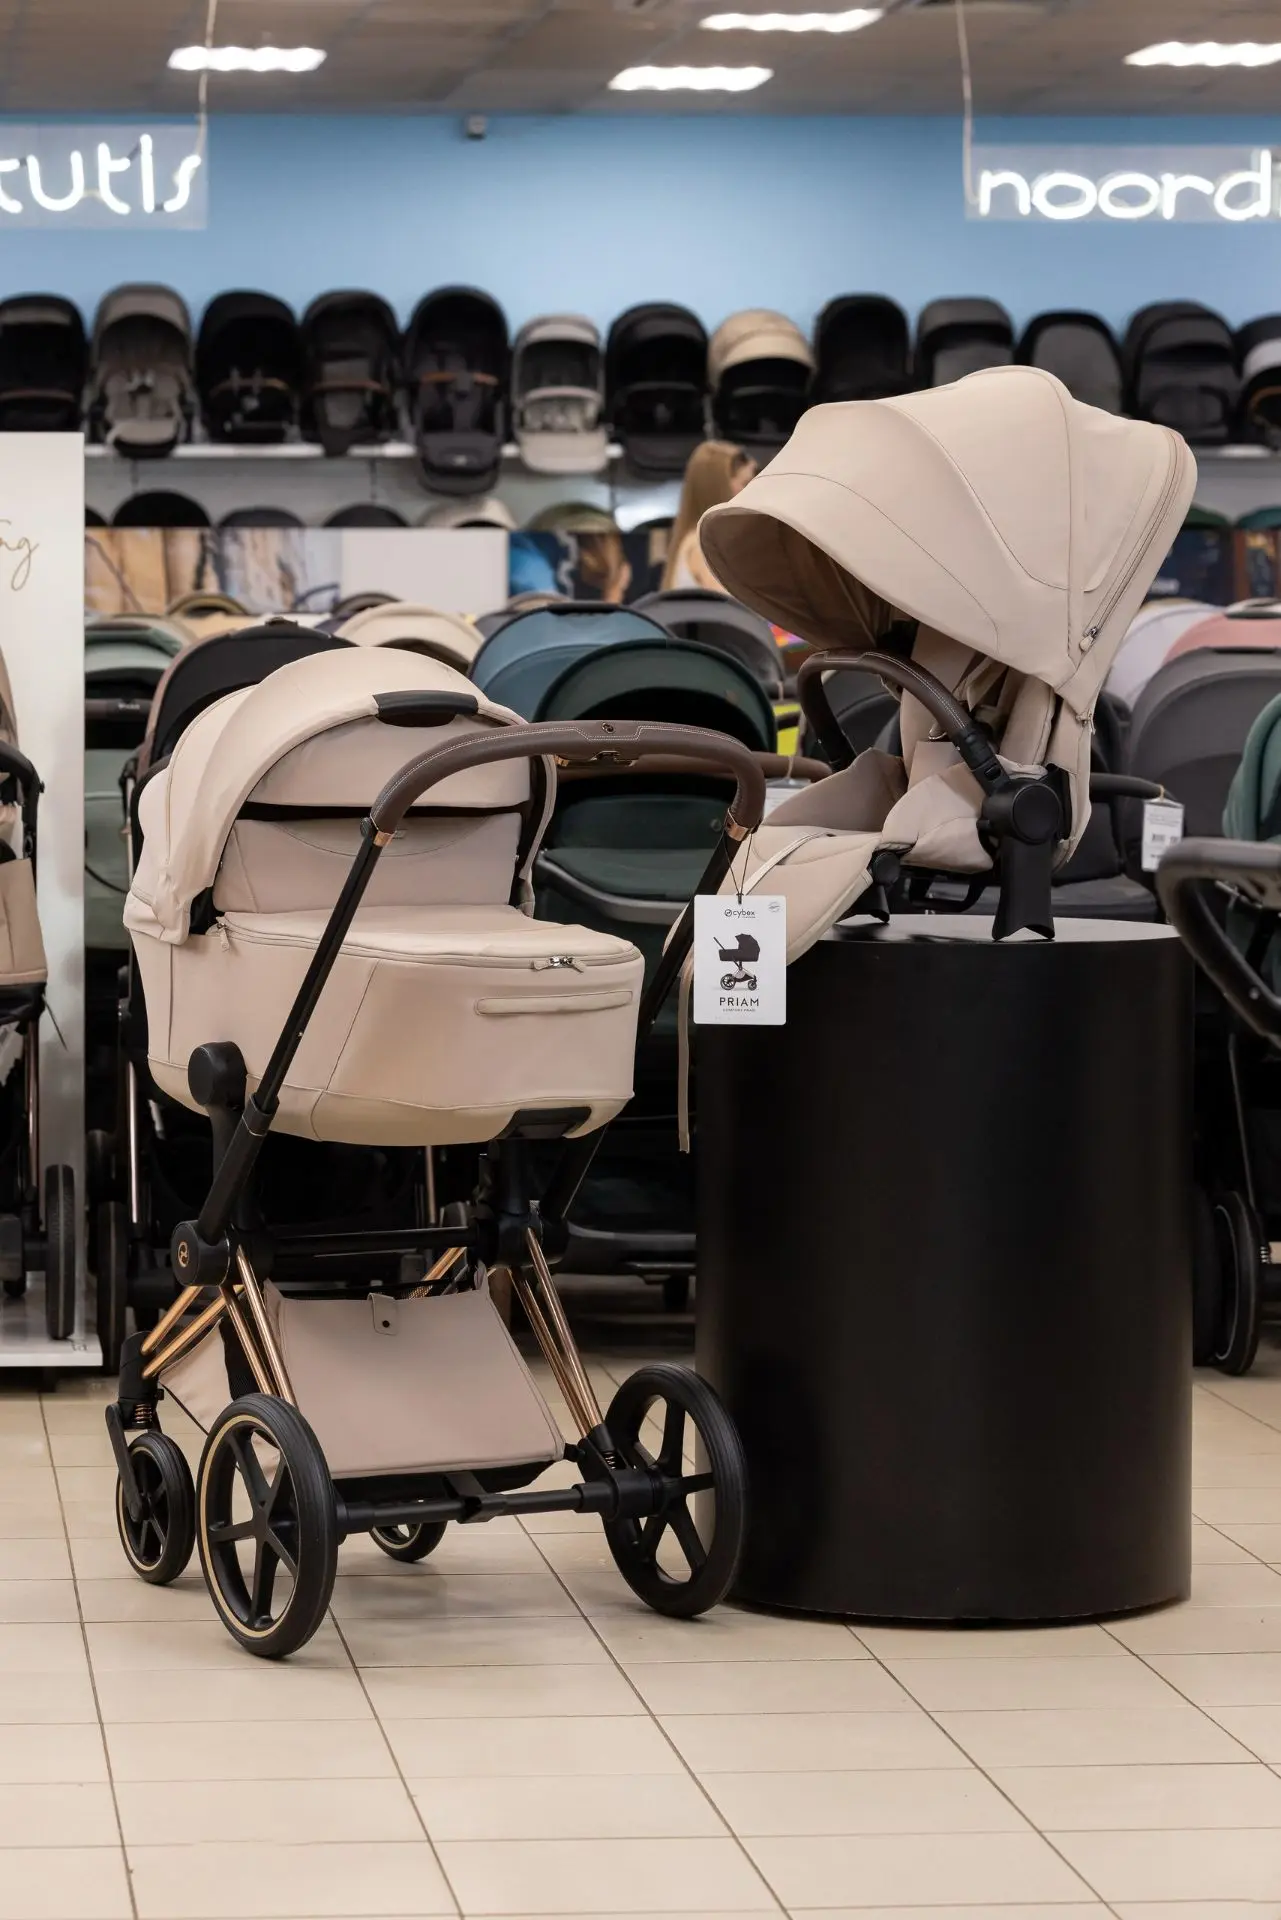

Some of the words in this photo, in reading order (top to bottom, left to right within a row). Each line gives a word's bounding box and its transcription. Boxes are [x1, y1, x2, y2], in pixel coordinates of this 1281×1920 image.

[979, 149, 1281, 221] noord
[733, 908, 755, 918] cybex
[719, 996, 759, 1007] PRIAM
